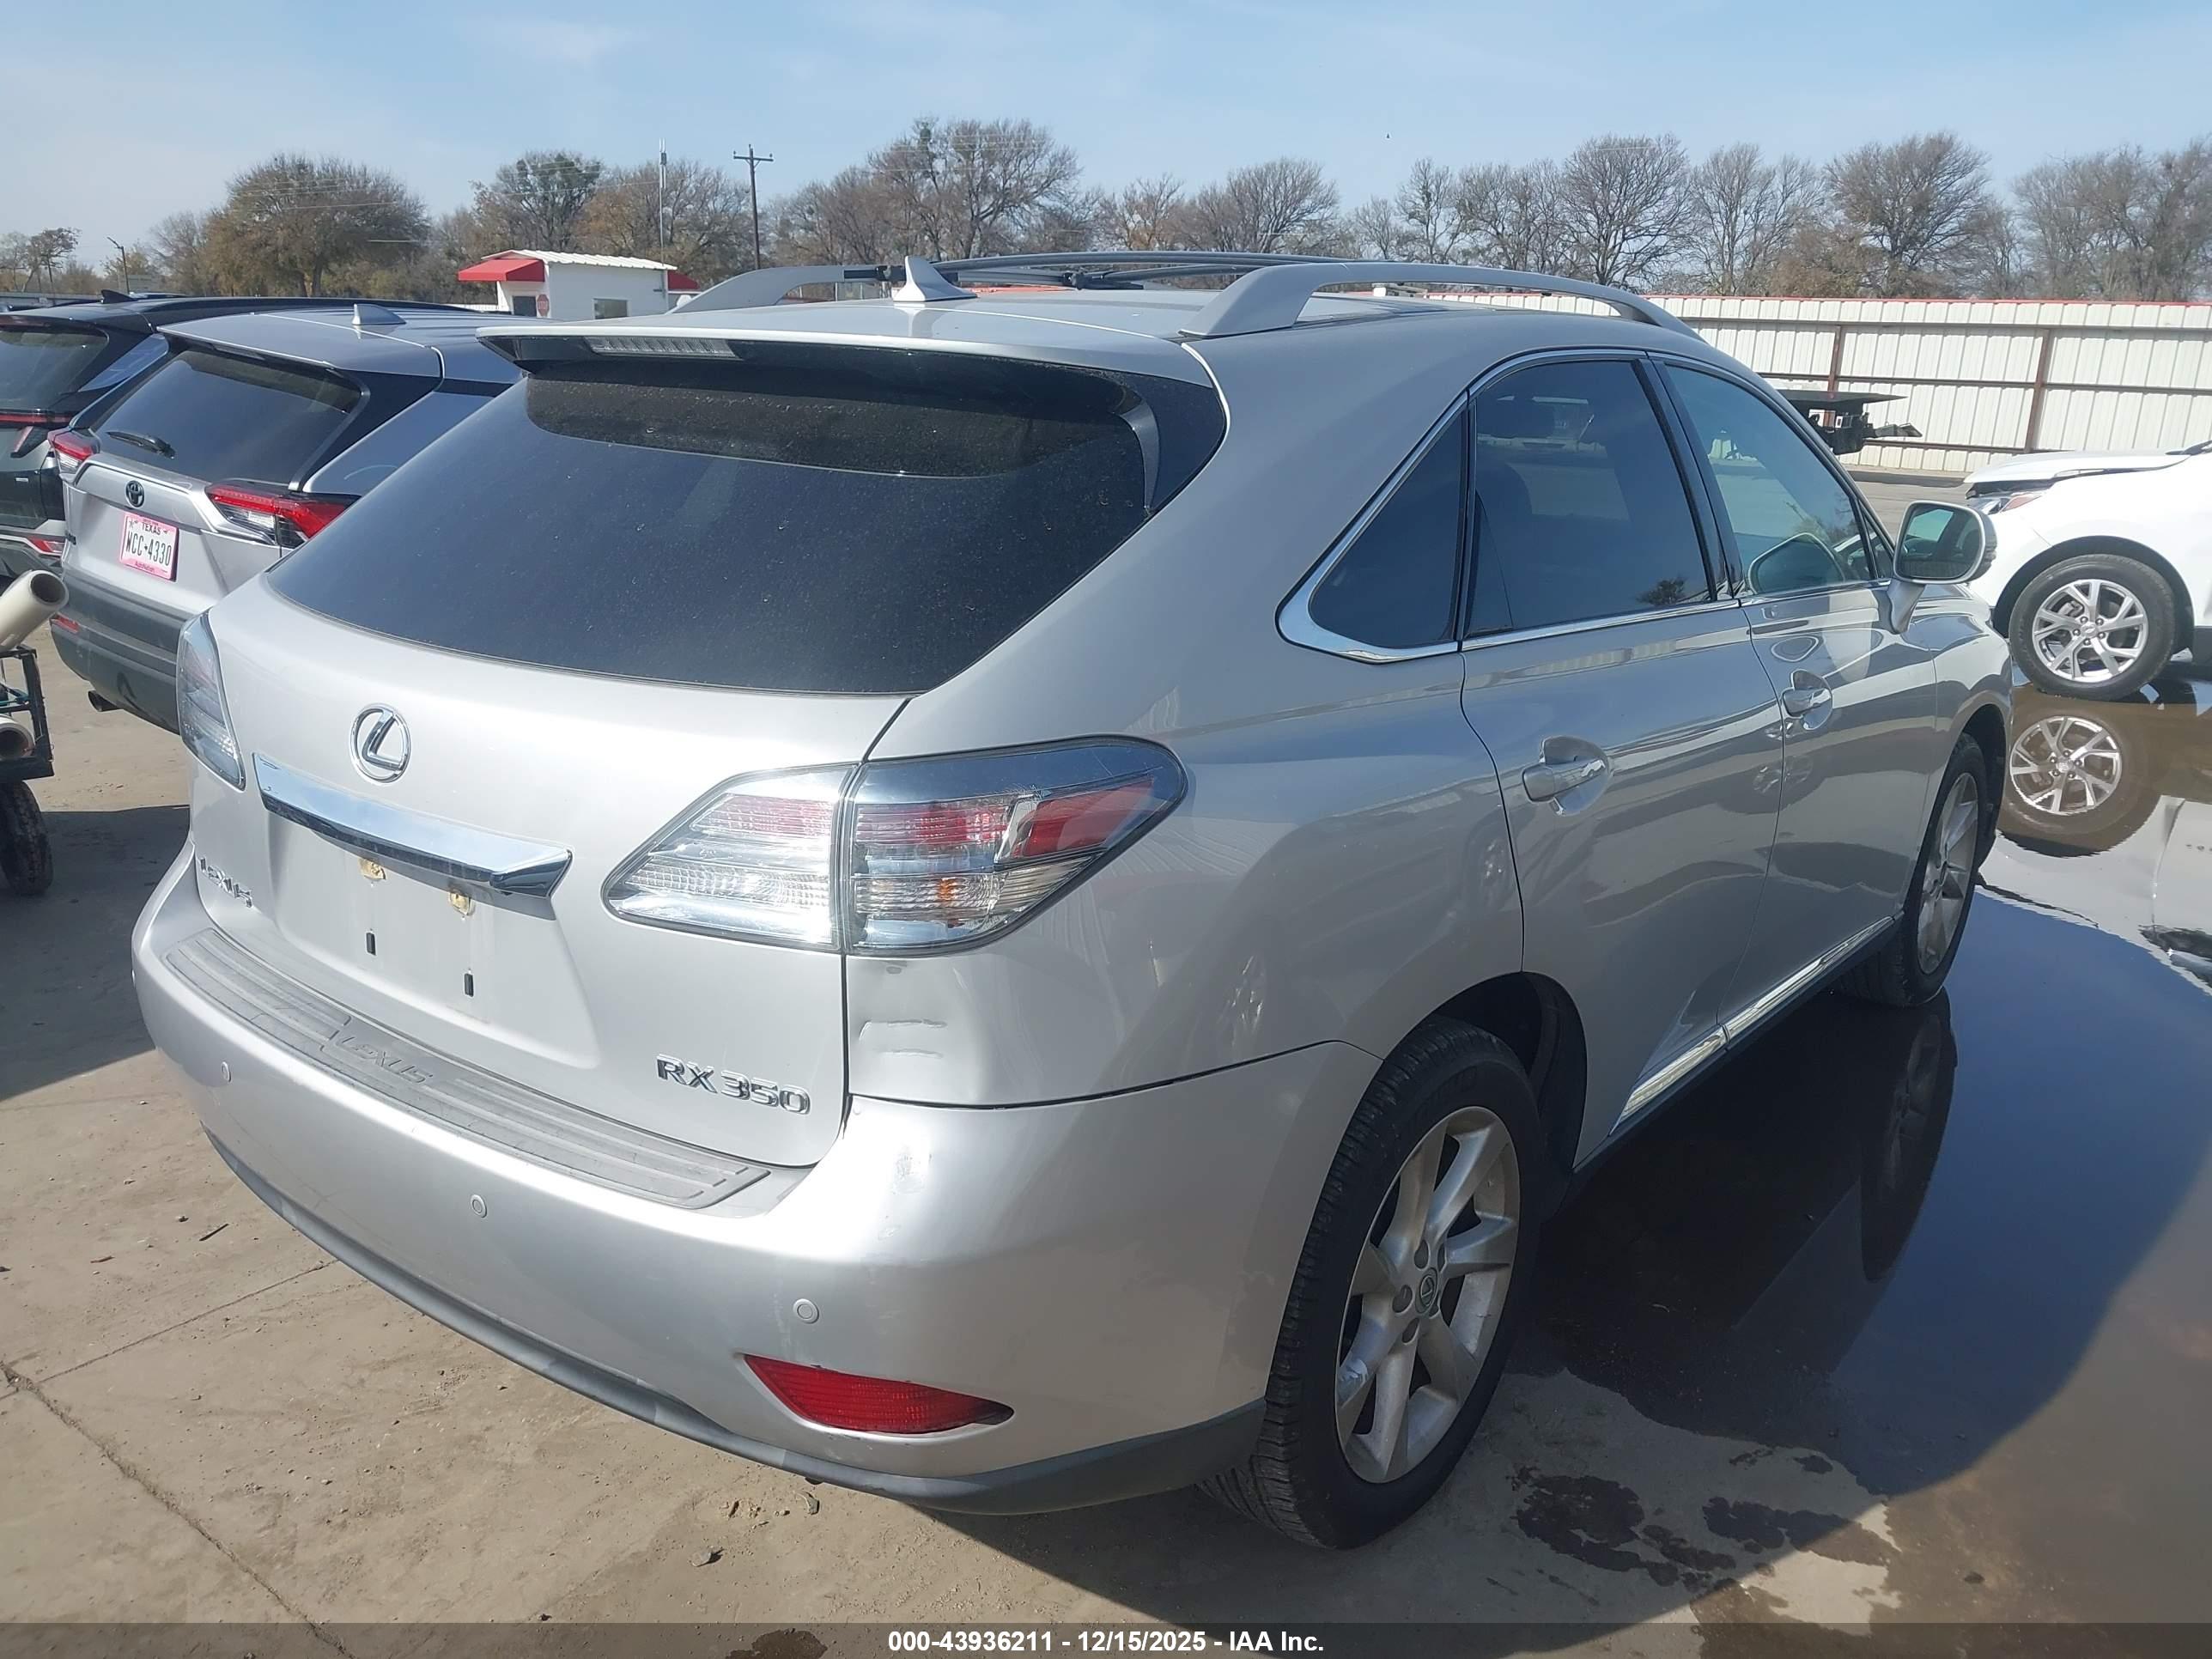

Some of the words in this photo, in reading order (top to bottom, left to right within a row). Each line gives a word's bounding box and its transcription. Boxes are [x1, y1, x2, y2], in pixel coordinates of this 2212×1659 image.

[142, 522, 161, 536] TEXAS
[336, 1036, 434, 1084] LEXUS
[657, 1054, 718, 1094] RX
[720, 1070, 811, 1115] 350
